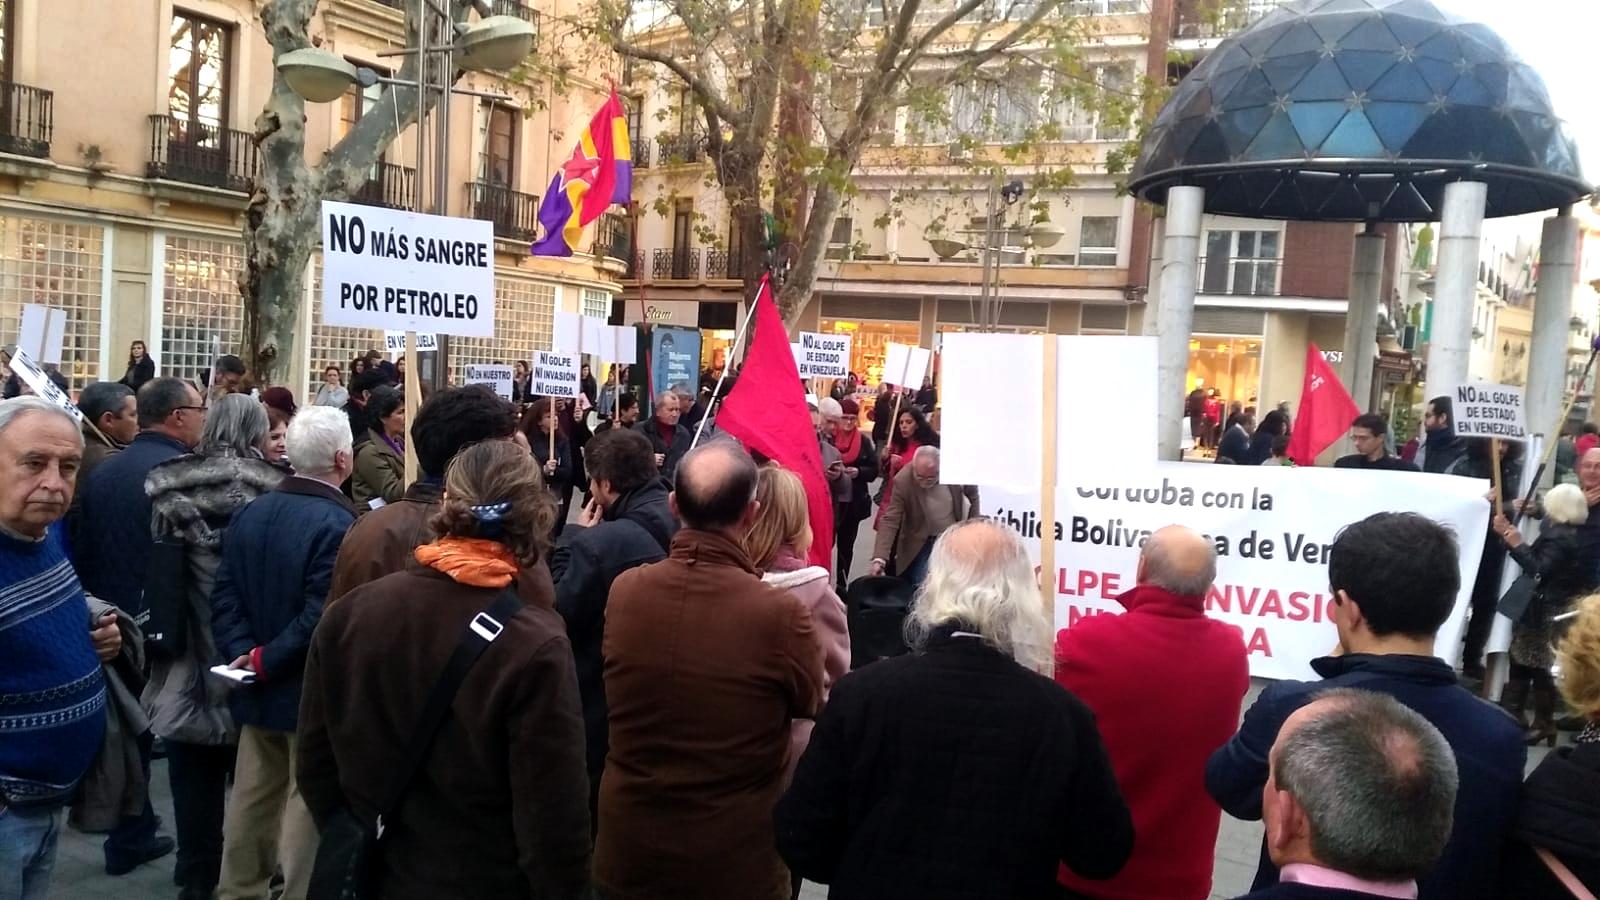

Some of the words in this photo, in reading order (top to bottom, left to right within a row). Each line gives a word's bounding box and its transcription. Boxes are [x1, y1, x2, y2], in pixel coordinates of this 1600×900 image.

[330, 213, 366, 255] NO
[371, 227, 409, 260] MÁS
[415, 236, 488, 268] SANGRE
[341, 282, 379, 312] POR
[385, 286, 478, 320] PETROLEO
[646, 305, 672, 320] Etam
[388, 335, 397, 348] EN
[397, 335, 436, 348] VEUELA
[803, 334, 813, 349] NO
[814, 340, 821, 350] AL
[822, 341, 846, 352] GOLPE
[540, 352, 548, 365] NI
[549, 356, 571, 367] GOLPE
[806, 351, 814, 362] DE
[815, 352, 839, 363] ESTADO
[466, 365, 476, 380] NO
[483, 370, 511, 380] NUESTRO
[535, 367, 543, 379] NI
[800, 363, 808, 374] EN
[809, 364, 846, 377] VENEZUELA
[536, 381, 544, 393] NI
[545, 384, 574, 396] GUERRA
[1458, 386, 1476, 403] NO
[1479, 392, 1490, 403] AL
[1493, 392, 1520, 407] GOLPE
[1466, 407, 1480, 418] DE
[1482, 407, 1516, 421] ESTADO
[1458, 421, 1472, 433] EN
[1474, 422, 1525, 437] VENEZUELA
[1202, 491, 1244, 509] con
[1252, 487, 1273, 511] la
[1239, 530, 1275, 560] de
